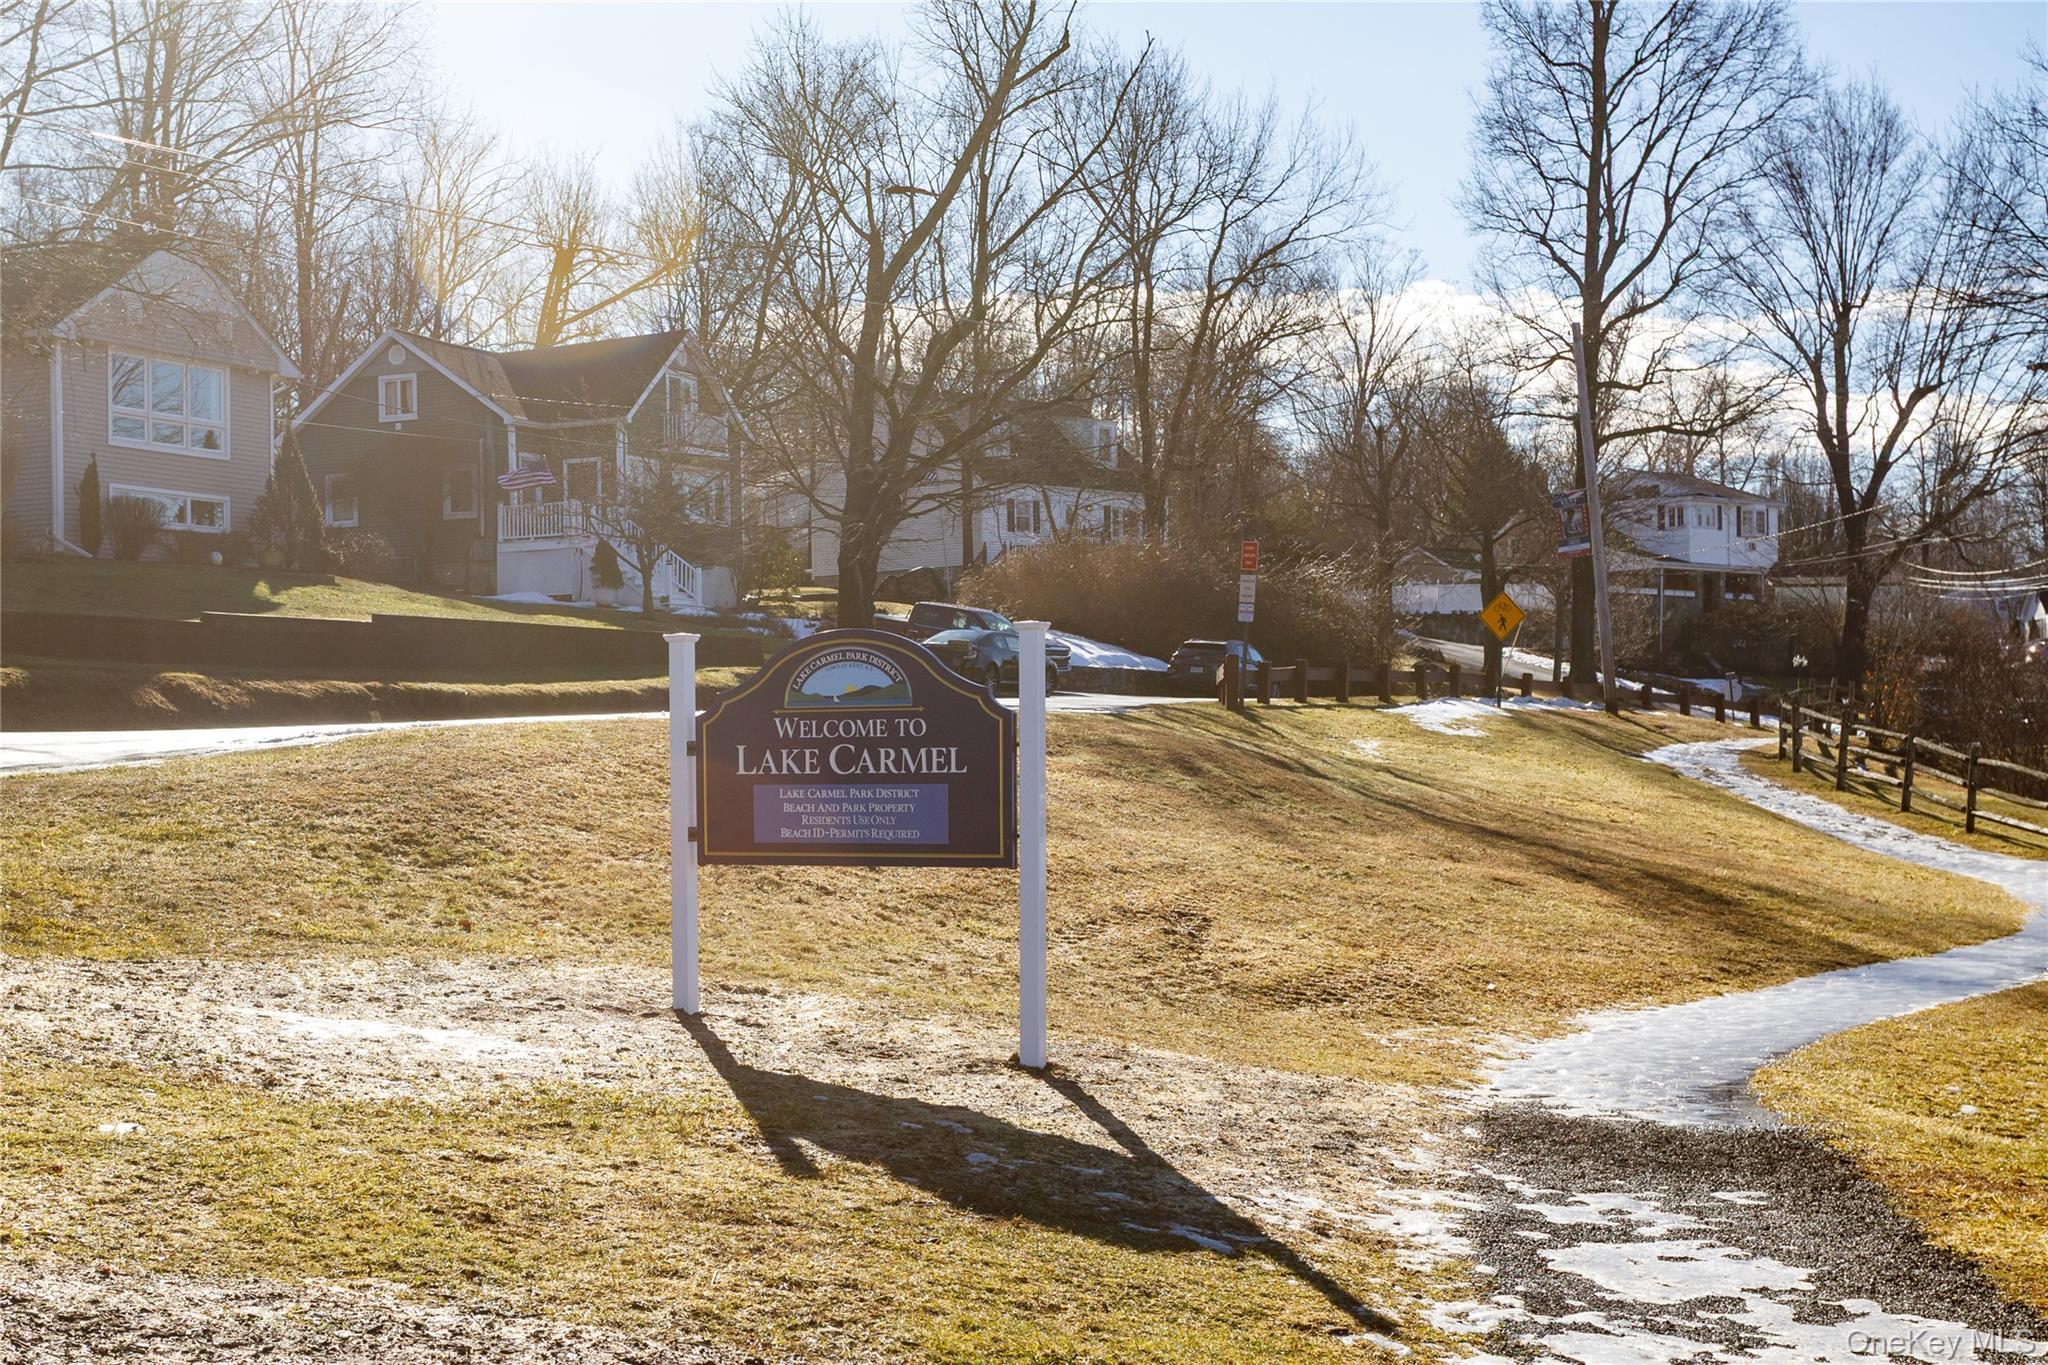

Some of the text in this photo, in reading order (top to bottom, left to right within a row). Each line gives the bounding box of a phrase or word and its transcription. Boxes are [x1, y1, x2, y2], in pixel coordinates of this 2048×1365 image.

[792, 652, 903, 690] LAKE CARMEL PARK DISTRICT
[774, 717, 927, 739] WELCOME TO
[736, 744, 968, 775] LAKE CARMEL
[779, 789, 920, 798] LAKE CARMEL PARK DISTRICT
[784, 803, 916, 812] BEACH AND PARK PROPERTY
[802, 816, 896, 825] RESIDENTS USE ONLY
[781, 828, 810, 838] BEACH
[872, 829, 920, 840] REQUIRED
